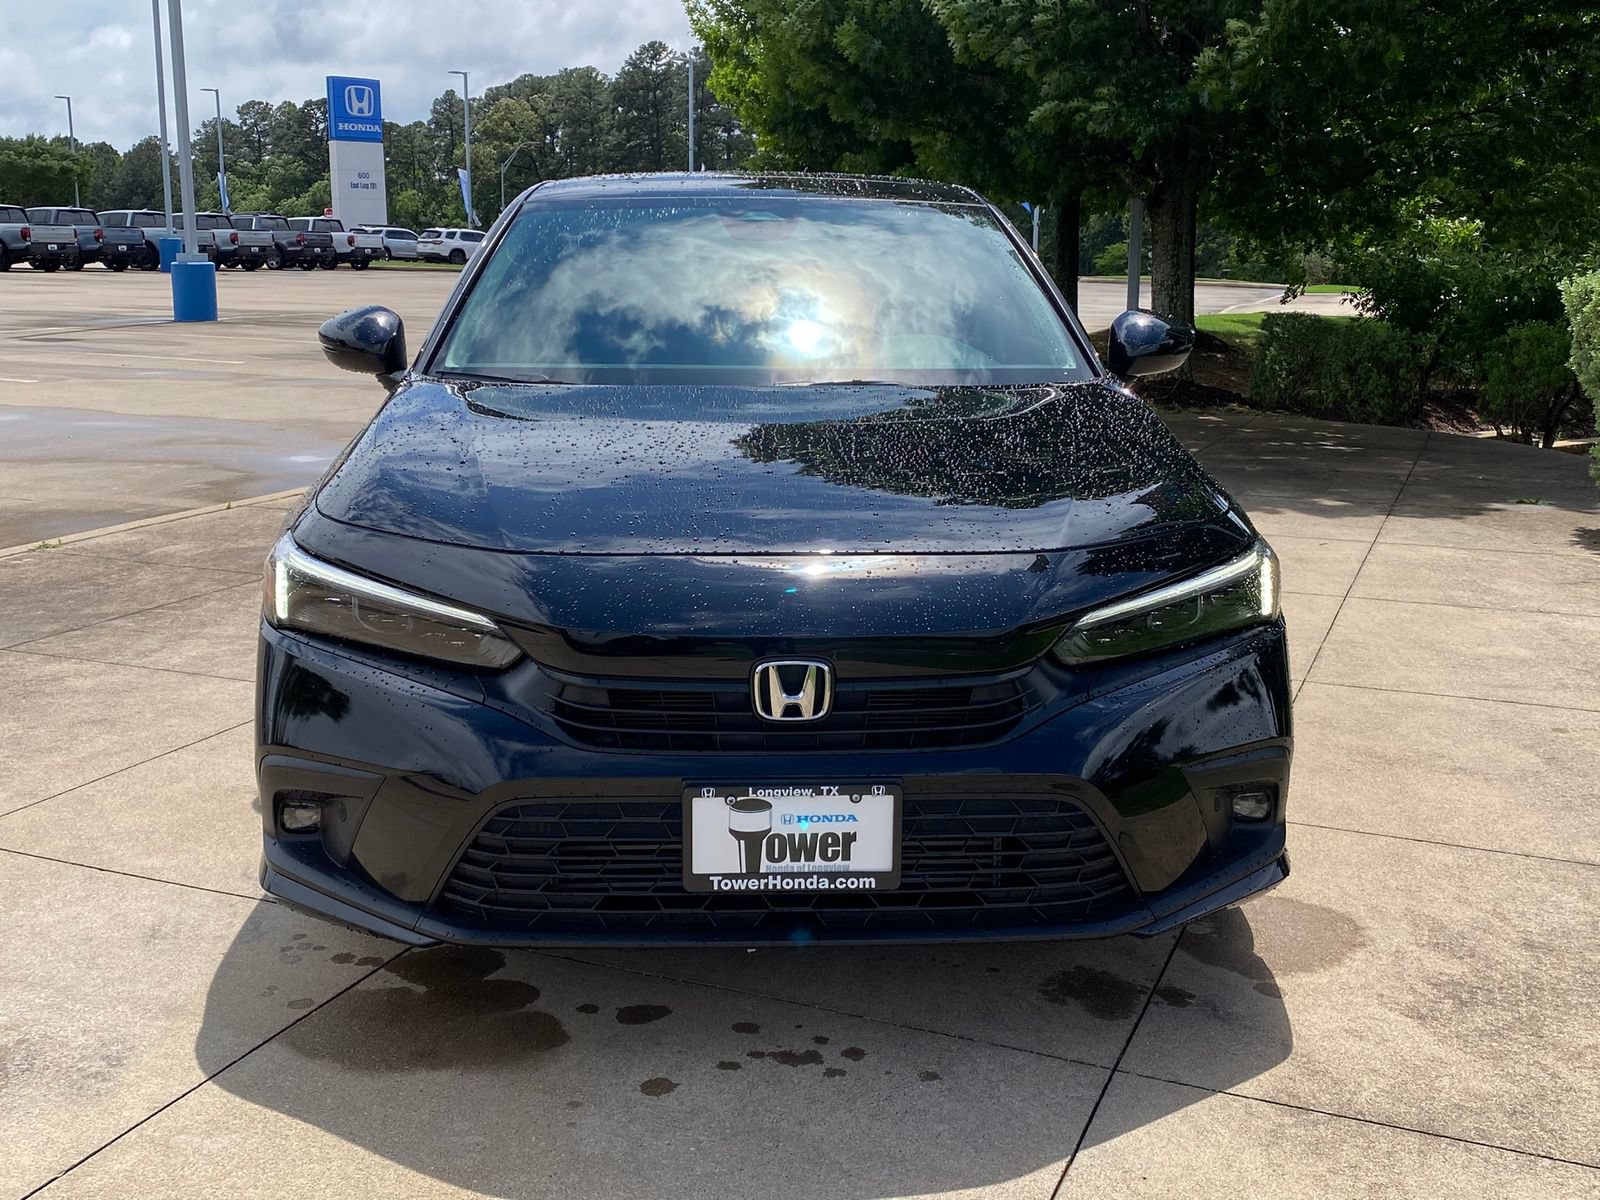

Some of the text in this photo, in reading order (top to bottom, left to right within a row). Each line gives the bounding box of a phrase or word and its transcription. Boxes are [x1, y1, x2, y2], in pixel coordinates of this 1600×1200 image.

[338, 123, 381, 132] HONDA
[748, 786, 840, 799] Longview, TX
[796, 814, 858, 823] HONDA
[709, 874, 876, 890] TowerHonda.com
